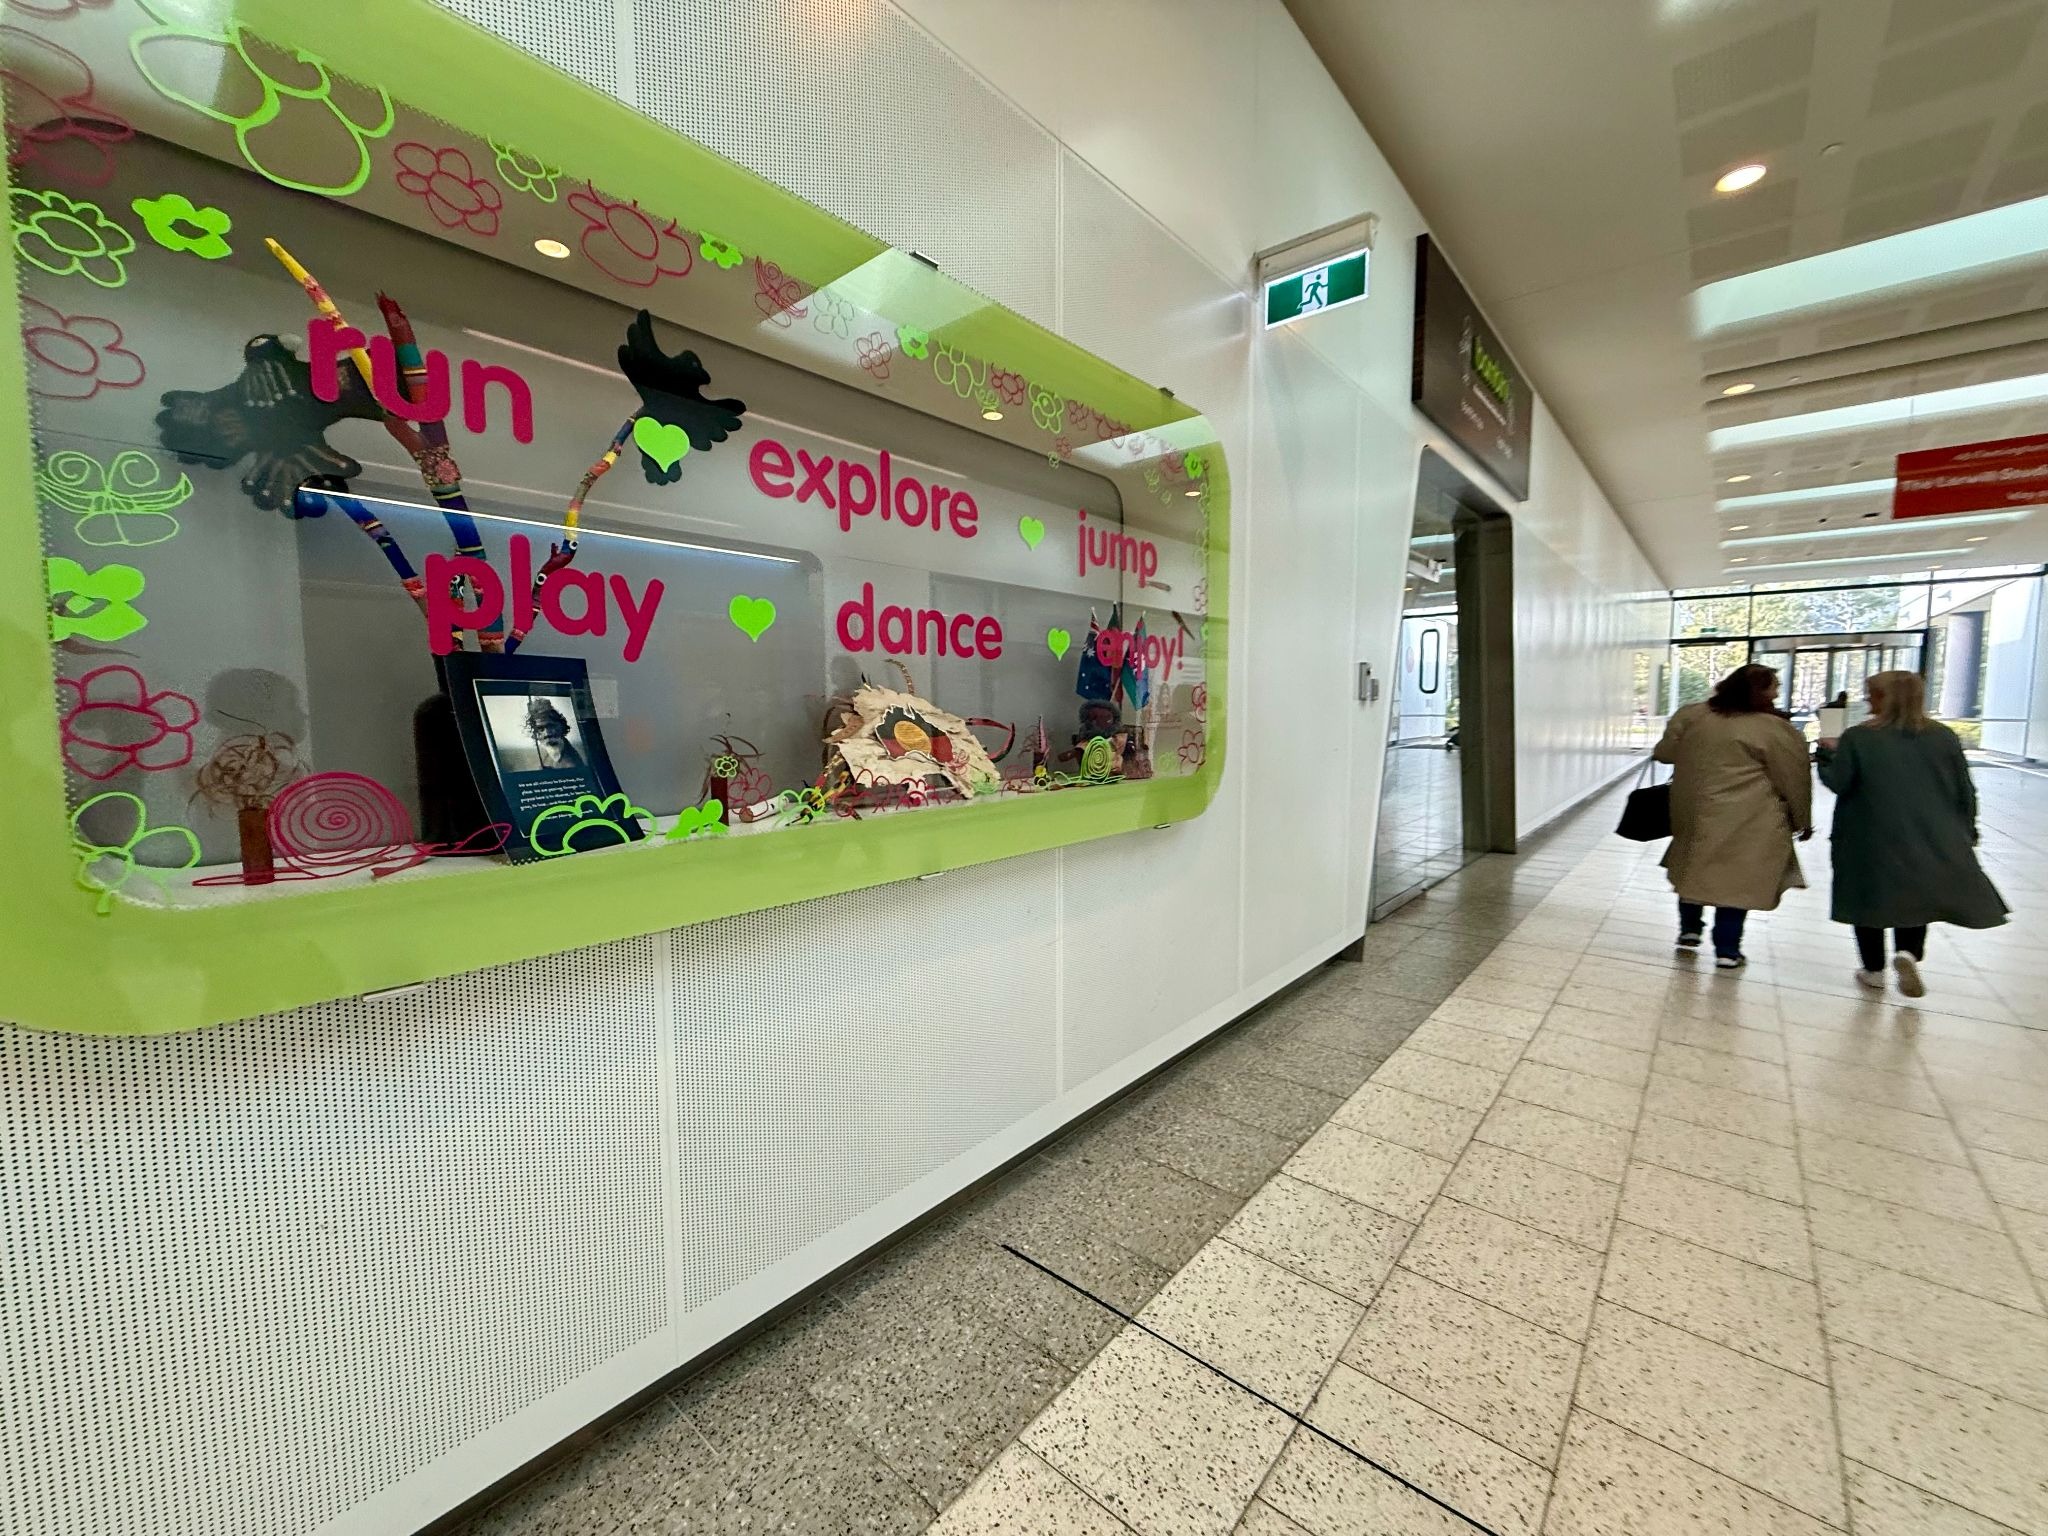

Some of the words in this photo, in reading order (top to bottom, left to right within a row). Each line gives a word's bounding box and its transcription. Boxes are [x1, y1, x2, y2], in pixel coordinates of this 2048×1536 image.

[307, 317, 534, 444] run
[749, 439, 980, 539] explore
[1078, 508, 1158, 589] jump
[420, 533, 665, 663] play
[836, 581, 1004, 661] dance
[1096, 626, 1184, 682] enjoy!
